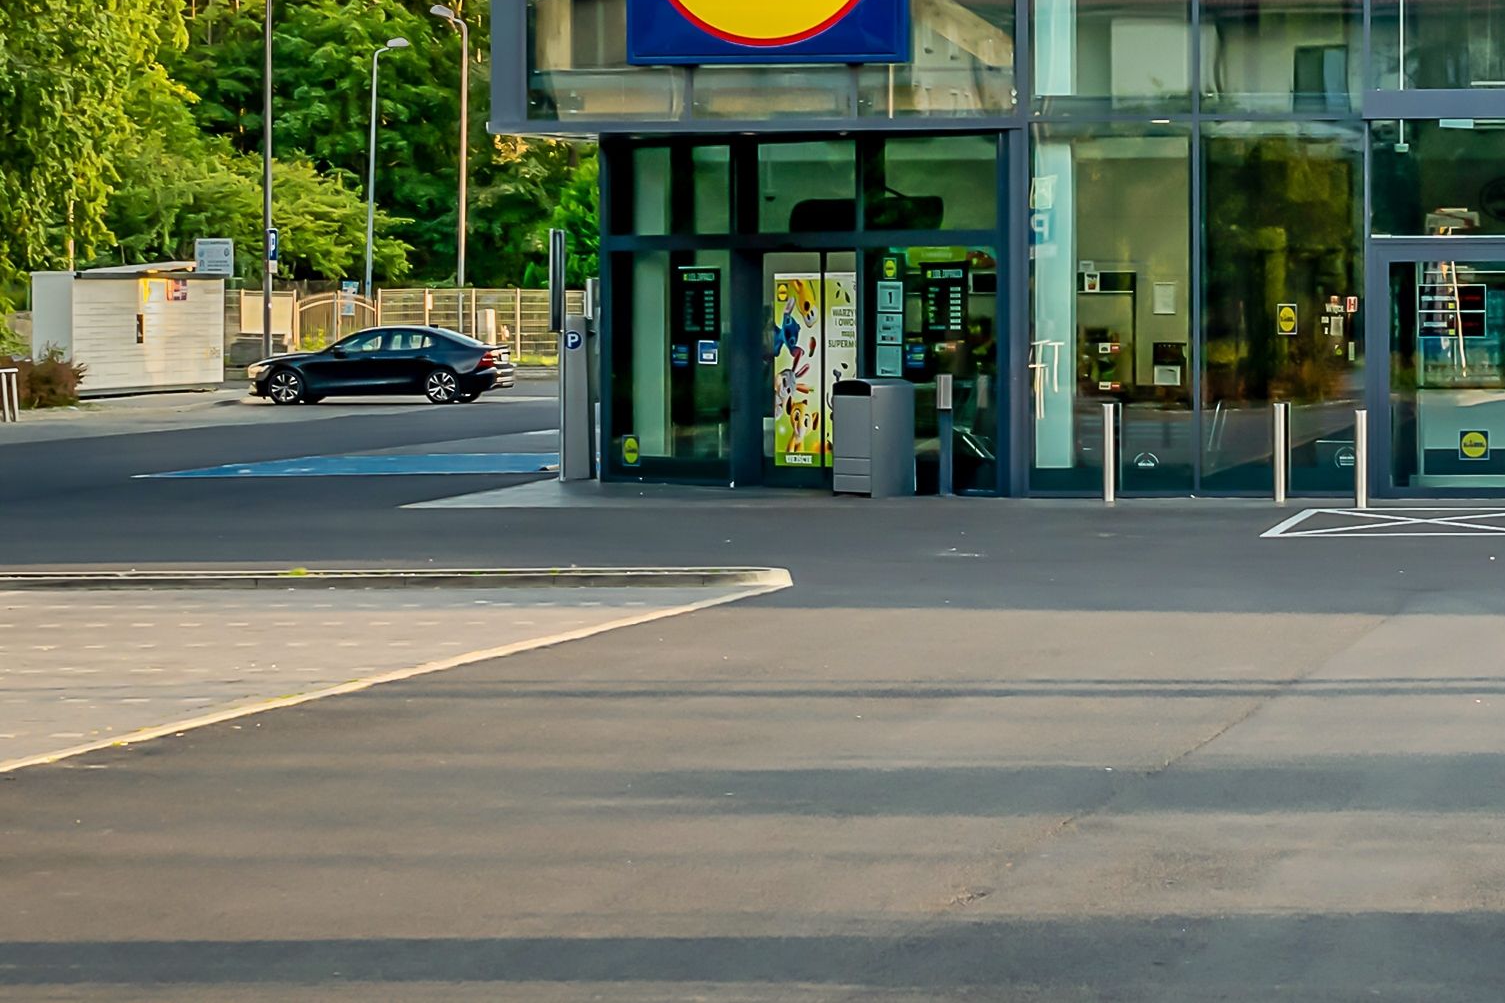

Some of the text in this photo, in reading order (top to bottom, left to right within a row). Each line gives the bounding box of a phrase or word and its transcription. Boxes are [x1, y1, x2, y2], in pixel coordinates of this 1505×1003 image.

[832, 308, 856, 317] WARZY
[839, 318, 856, 327] OWO
[567, 333, 579, 348] P
[828, 339, 856, 348] SUPERM
